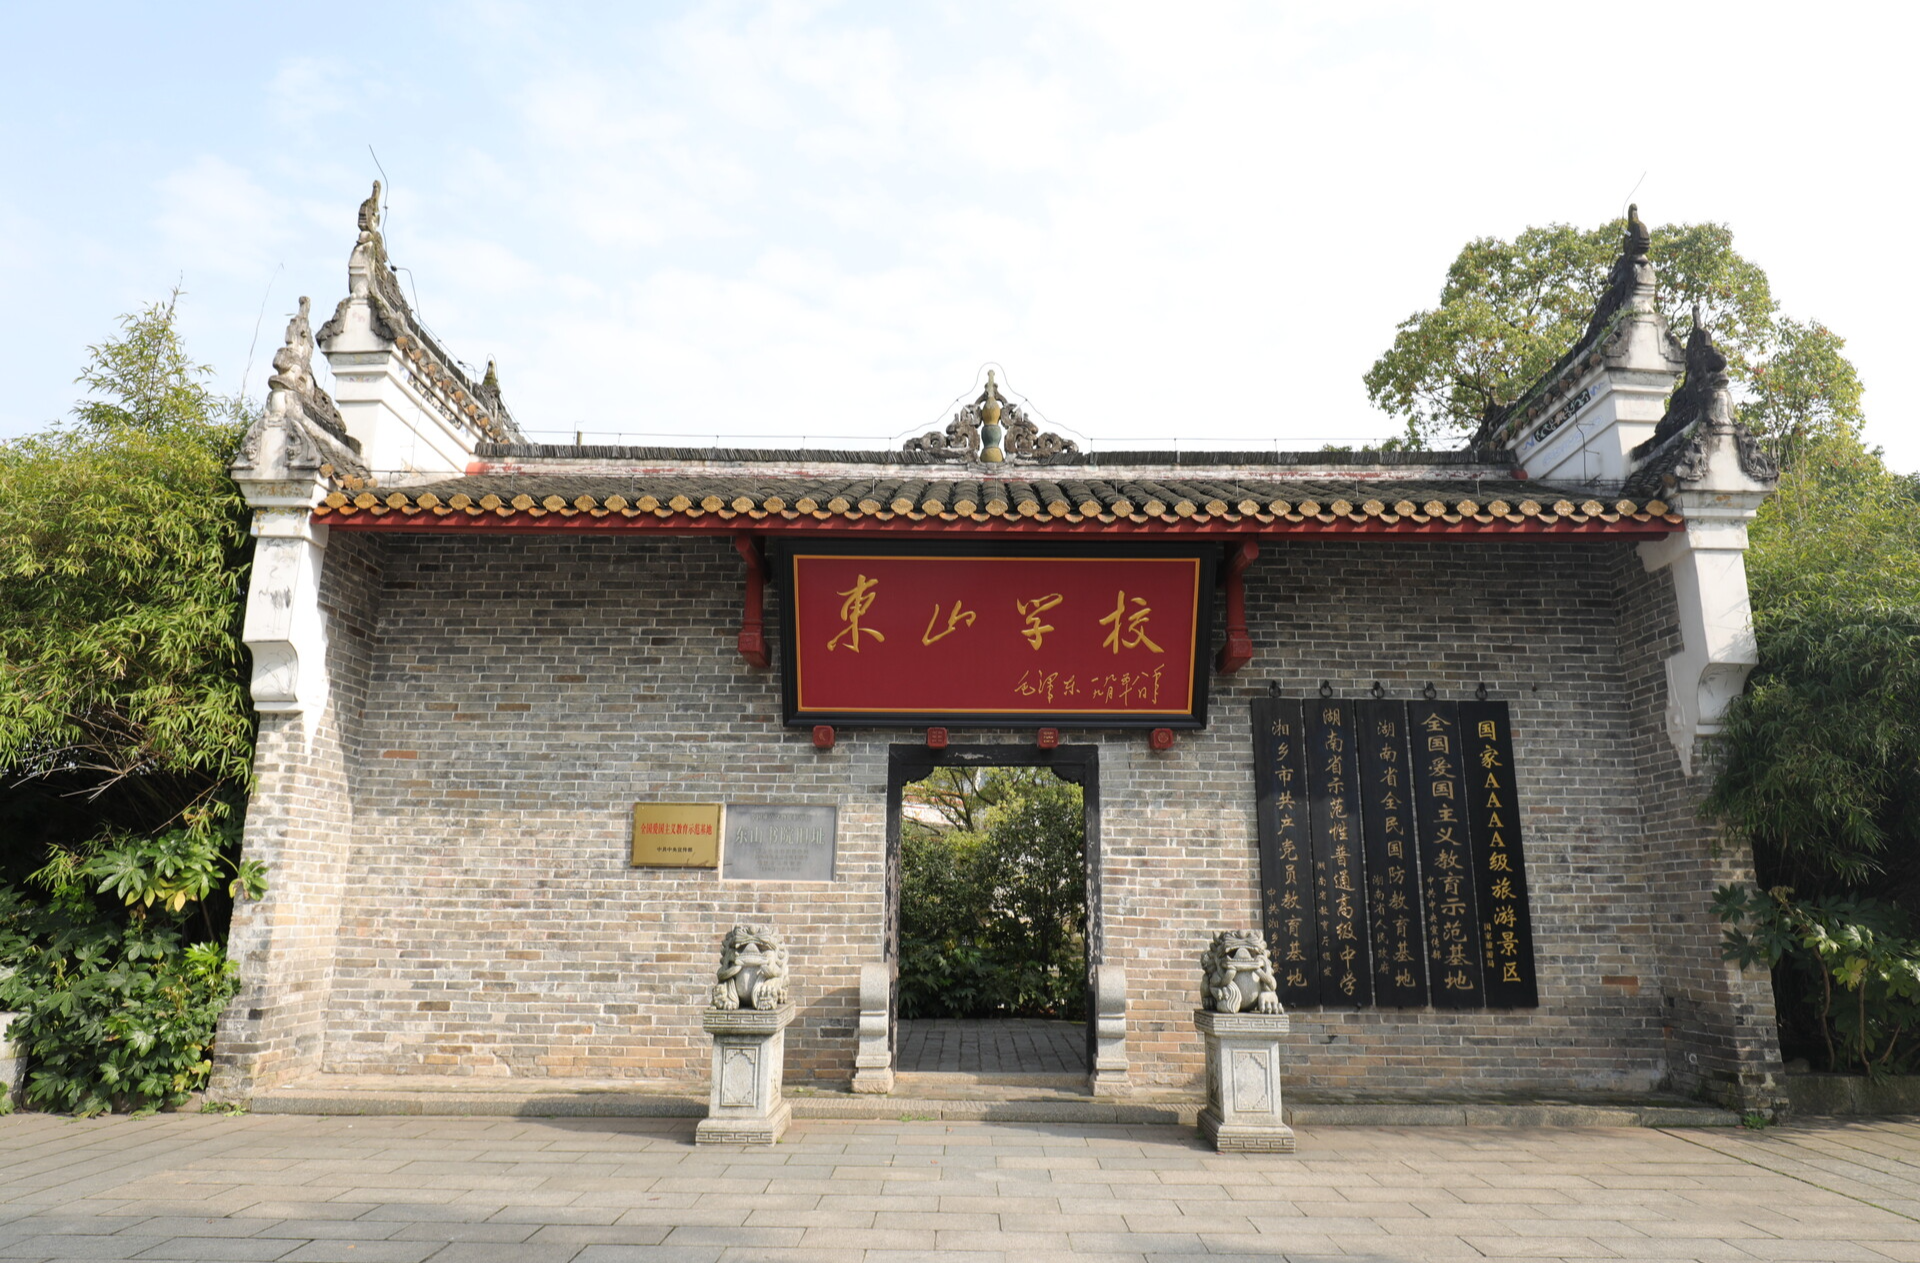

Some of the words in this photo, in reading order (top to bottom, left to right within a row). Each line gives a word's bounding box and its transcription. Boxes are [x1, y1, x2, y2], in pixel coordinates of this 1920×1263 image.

[640, 823, 713, 835] 全国爱国主义教育示范基地
[1271, 718, 1307, 988] 湘乡市共产党员教育基地
[1322, 706, 1358, 996] 湖南省示范性普通高级中学
[1372, 874, 1391, 976] 湖南省人民政府
[1376, 720, 1416, 988] 湖南省全民国防教育基地
[1420, 712, 1474, 991] 全国爱国主义教育示范基地
[1426, 875, 1442, 961] 中共中央宣传部
[1477, 720, 1521, 983] 国家AAAA级旅游景区
